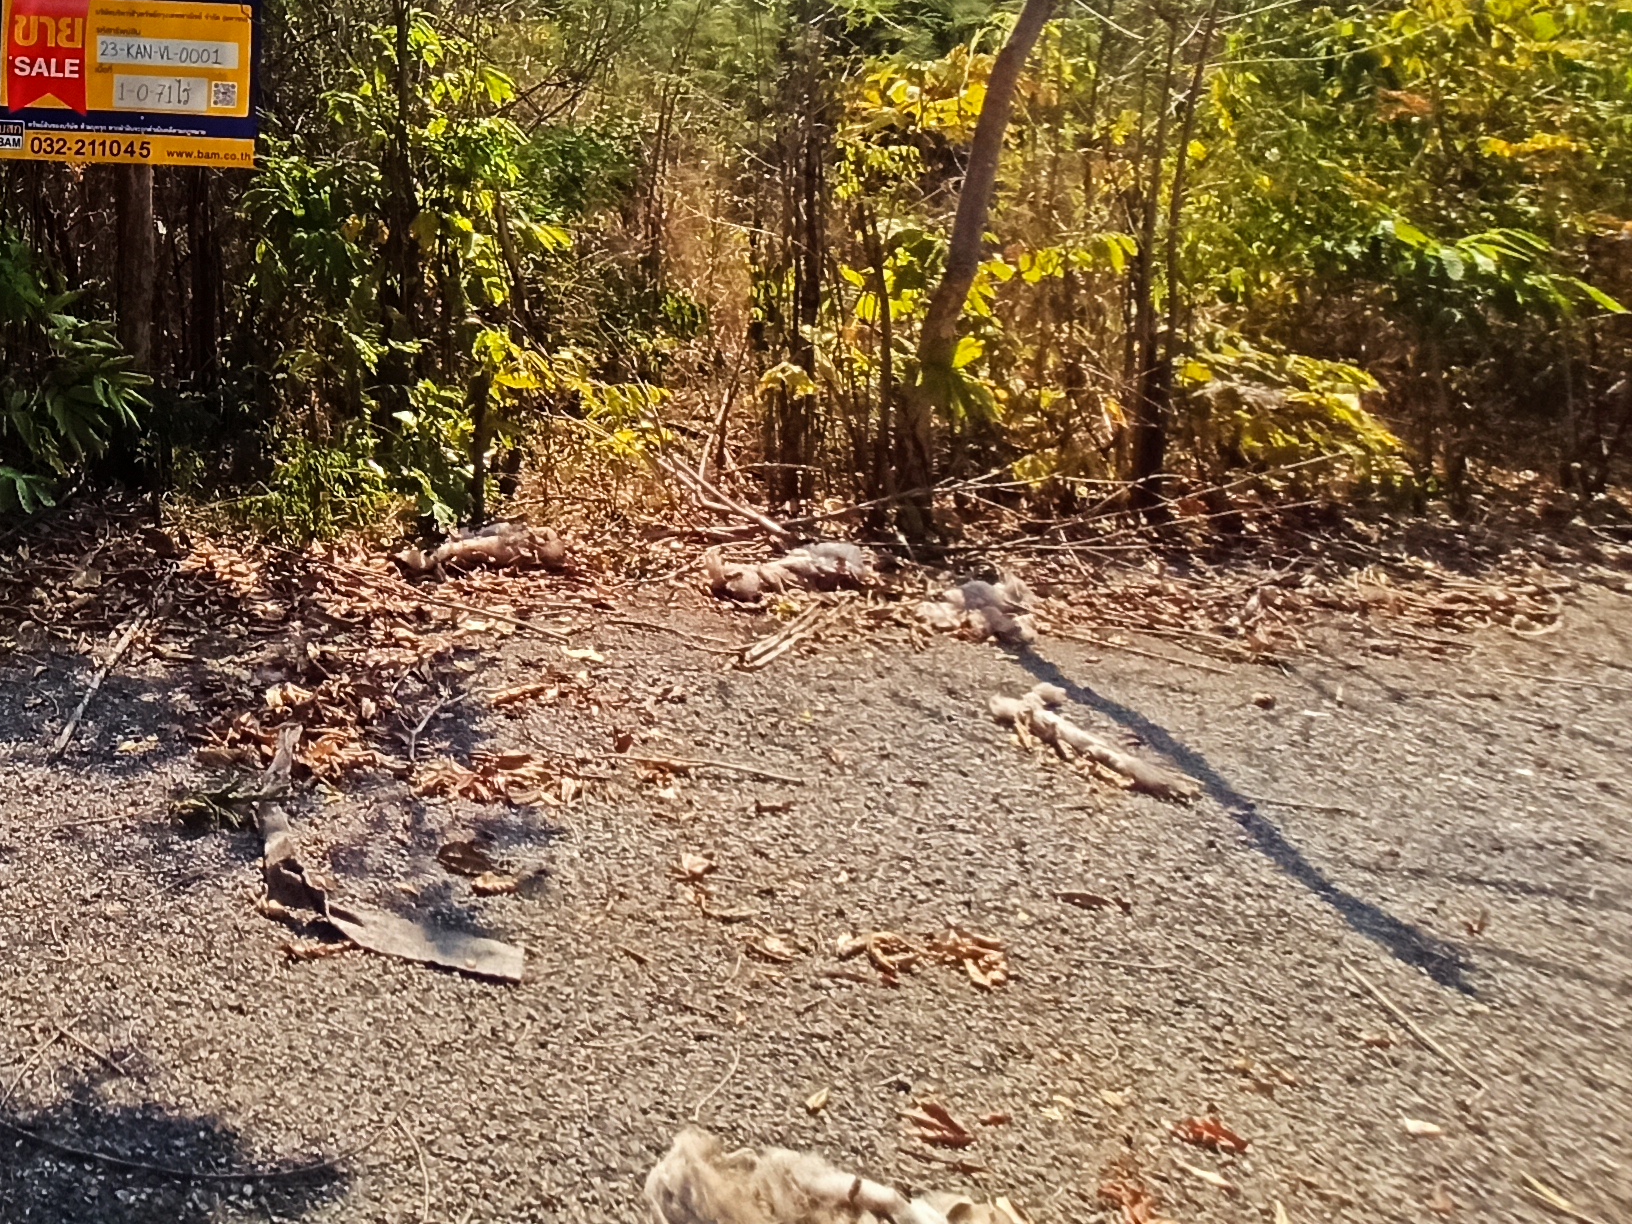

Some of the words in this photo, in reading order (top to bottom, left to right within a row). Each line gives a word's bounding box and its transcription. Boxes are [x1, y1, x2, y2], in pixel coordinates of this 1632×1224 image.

[14, 15, 82, 48] ขาย
[100, 40, 222, 65] 23-KAN-VL-0001
[14, 57, 79, 78] SALE
[30, 136, 151, 158] 032-211045
[166, 149, 251, 161] www.bam.co.th
